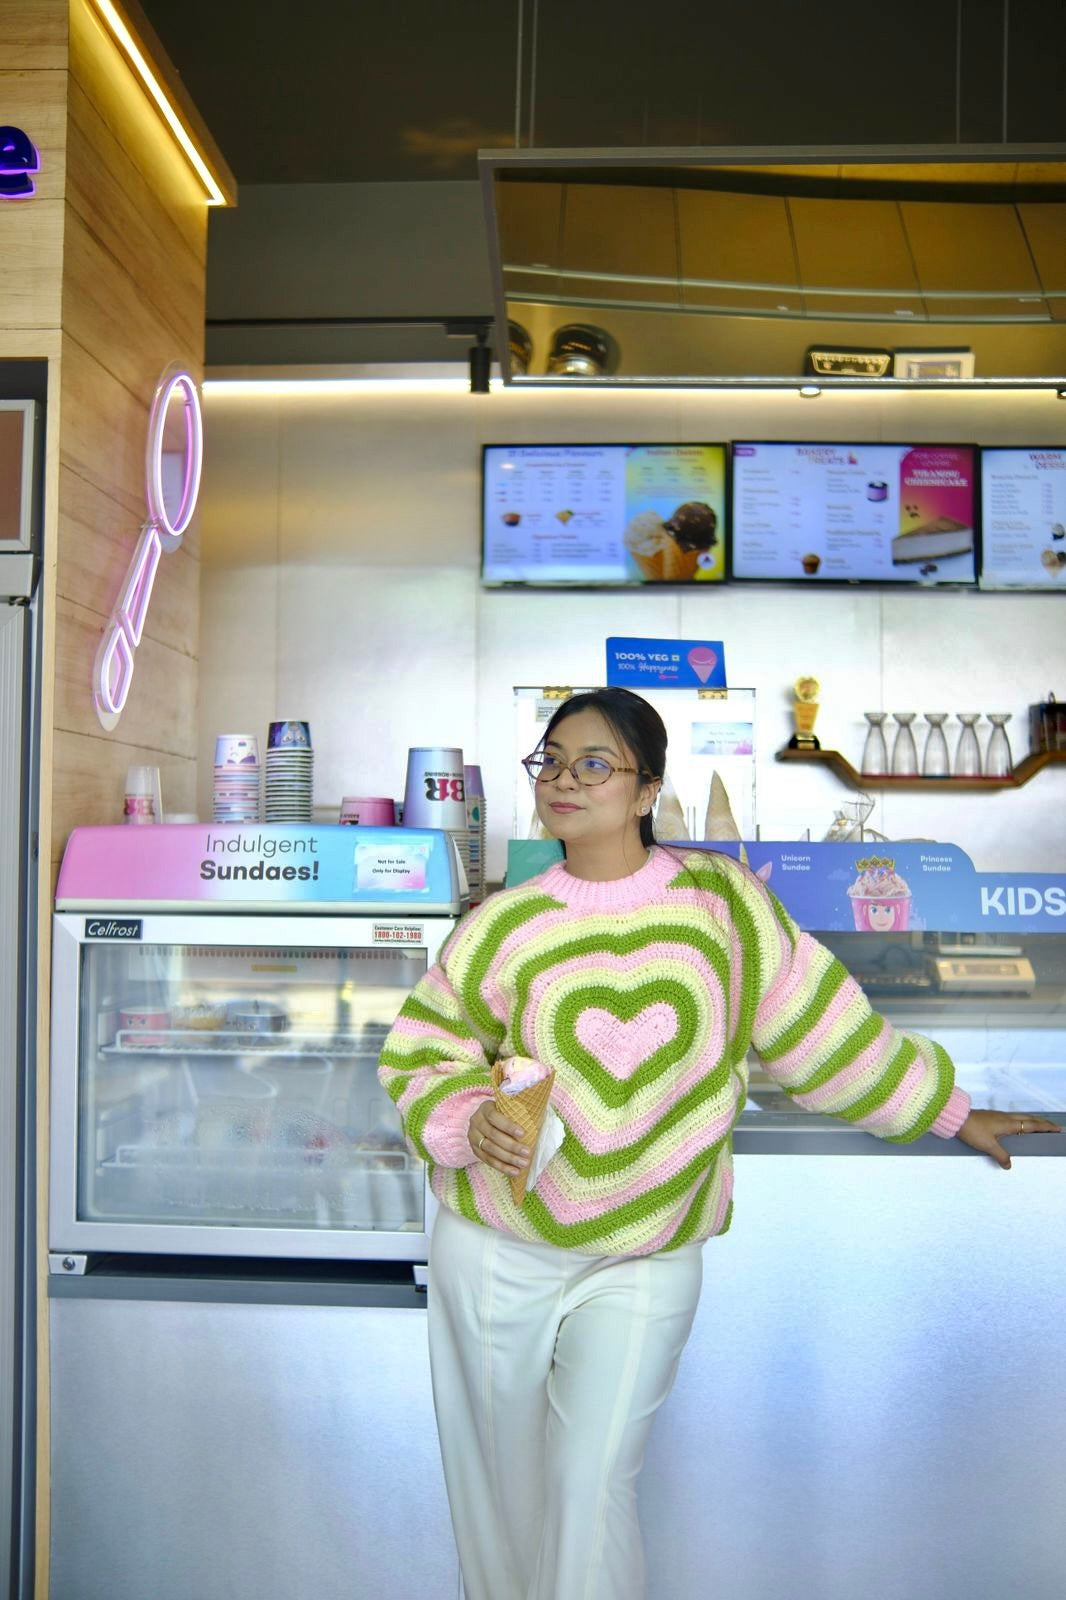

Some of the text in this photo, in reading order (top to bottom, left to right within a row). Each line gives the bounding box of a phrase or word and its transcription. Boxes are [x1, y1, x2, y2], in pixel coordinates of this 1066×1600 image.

[614, 652, 669, 662] 100% VEG
[206, 833, 319, 858] Indulgent
[920, 855, 952, 863] Princess
[200, 860, 319, 880] Sundaes!
[922, 864, 951, 872] Sundae
[981, 887, 1066, 916] KIDS
[88, 921, 138, 936] Celfrost
